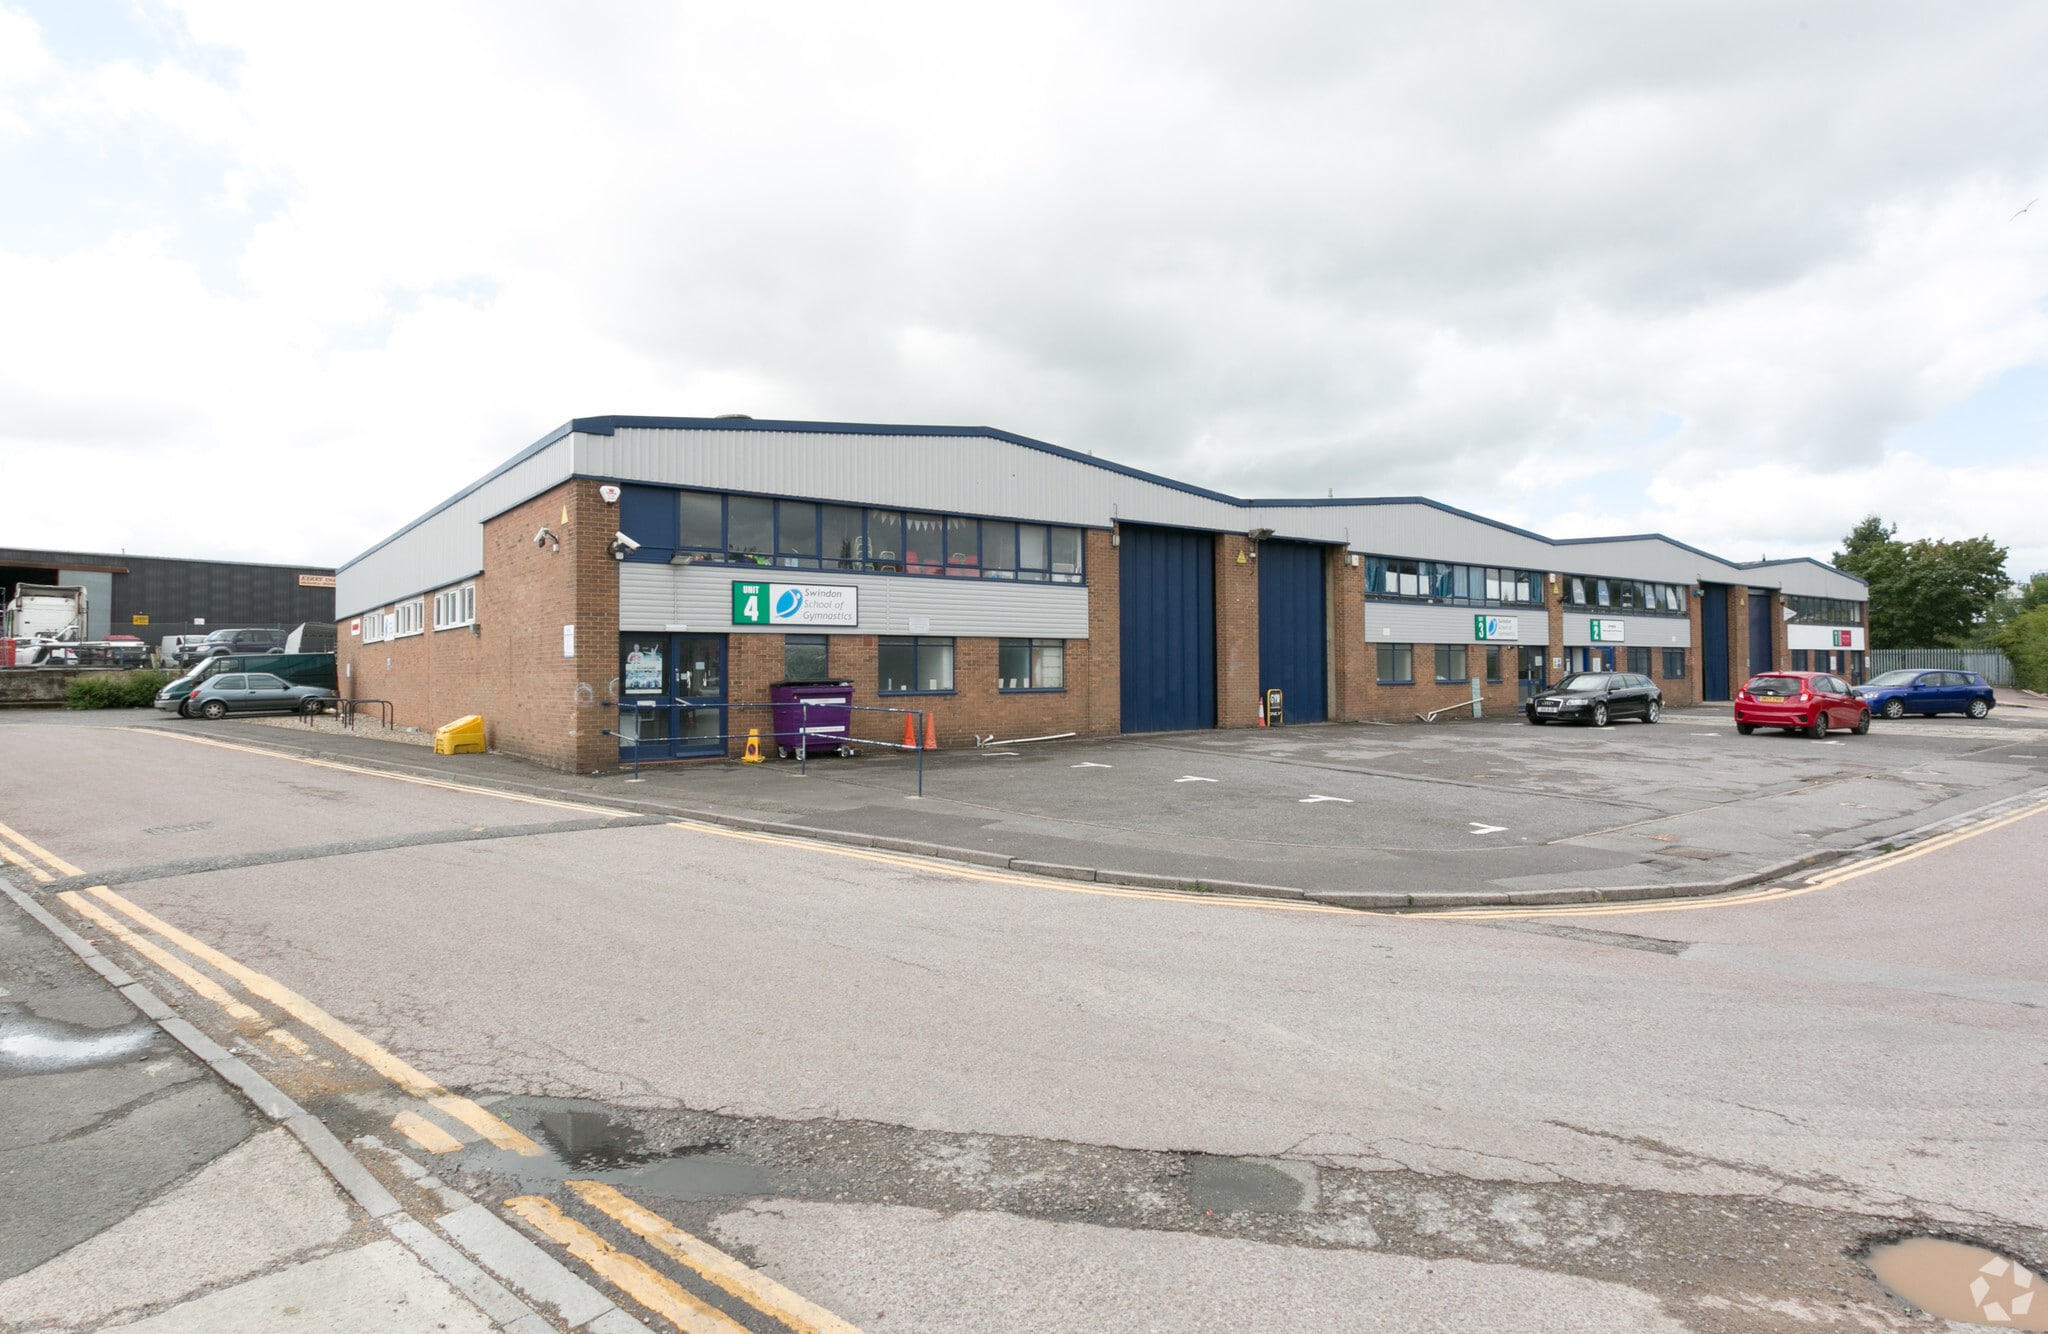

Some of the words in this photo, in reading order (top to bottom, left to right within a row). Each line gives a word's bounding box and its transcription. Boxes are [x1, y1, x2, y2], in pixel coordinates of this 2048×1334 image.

[743, 585, 760, 594] UNIT
[804, 589, 842, 598] Swindon
[744, 595, 759, 622] 4
[804, 600, 832, 609] School
[834, 601, 844, 610] of
[802, 611, 853, 622] Gymnastics
[1478, 622, 1484, 638] 3
[1593, 626, 1599, 640] 2
